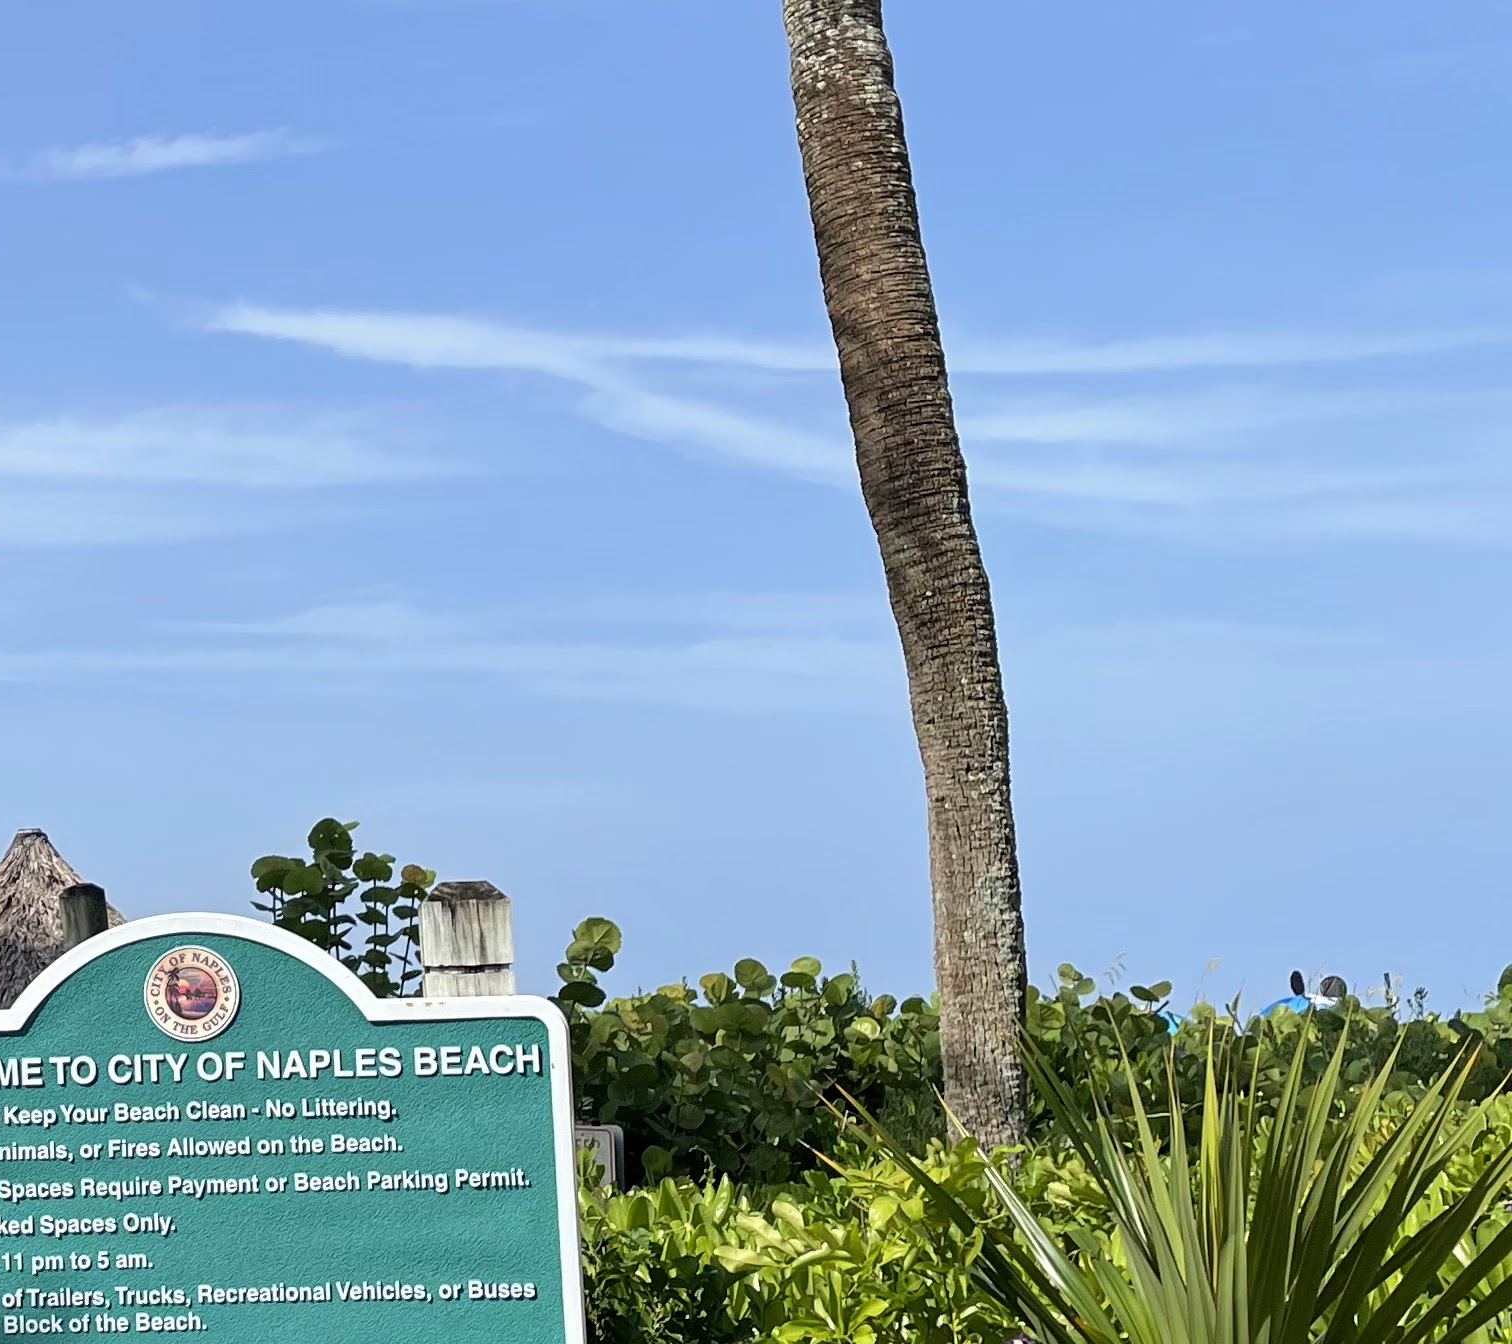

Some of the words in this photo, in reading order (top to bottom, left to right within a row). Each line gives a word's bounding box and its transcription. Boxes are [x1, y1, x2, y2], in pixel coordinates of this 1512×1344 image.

[150, 964, 170, 998] CITY
[169, 953, 187, 966] OF
[191, 952, 232, 995] NAPLES
[154, 1006, 171, 1024] ON
[172, 1020, 198, 1035] THE
[202, 1003, 229, 1032] GULF
[48, 1055, 97, 1085] TO
[107, 1052, 188, 1084] CITY
[196, 1051, 246, 1081] OF
[256, 1046, 402, 1080] NAPLES
[413, 1043, 540, 1076] BEACH
[3, 1105, 57, 1128] Keep
[59, 1103, 109, 1123] Your
[113, 1101, 180, 1122] Beach
[185, 1100, 246, 1120] Clean
[265, 1098, 295, 1118] No
[301, 1096, 397, 1120] Littering.
[79, 1143, 103, 1159] or
[107, 1138, 161, 1158] Fires
[166, 1135, 251, 1157] Allowed
[256, 1138, 284, 1155] on
[289, 1134, 324, 1154] the
[330, 1133, 403, 1153] Beach.
[80, 1175, 162, 1201] Require
[167, 1174, 260, 1199] Payment
[264, 1176, 288, 1192] or
[293, 1170, 360, 1192] Beach
[366, 1169, 448, 1193] Parking
[454, 1167, 530, 1188] Permit.
[39, 1214, 117, 1238] Spaces
[122, 1212, 176, 1236] Only.
[1, 1252, 23, 1271] 11
[31, 1254, 64, 1275] pm
[69, 1251, 92, 1270] to
[96, 1250, 110, 1270] 5
[115, 1252, 154, 1269] am.
[1, 1287, 23, 1308] of
[25, 1287, 111, 1309] Trailers,
[114, 1284, 191, 1308] Trucks,
[197, 1281, 331, 1304] Recreational
[335, 1279, 432, 1303] Vehicles,
[438, 1283, 462, 1300] or
[467, 1278, 536, 1299] Buses
[3, 1313, 64, 1334] Block
[68, 1312, 90, 1333] of
[94, 1312, 129, 1333] the
[135, 1311, 207, 1332] Beach.
